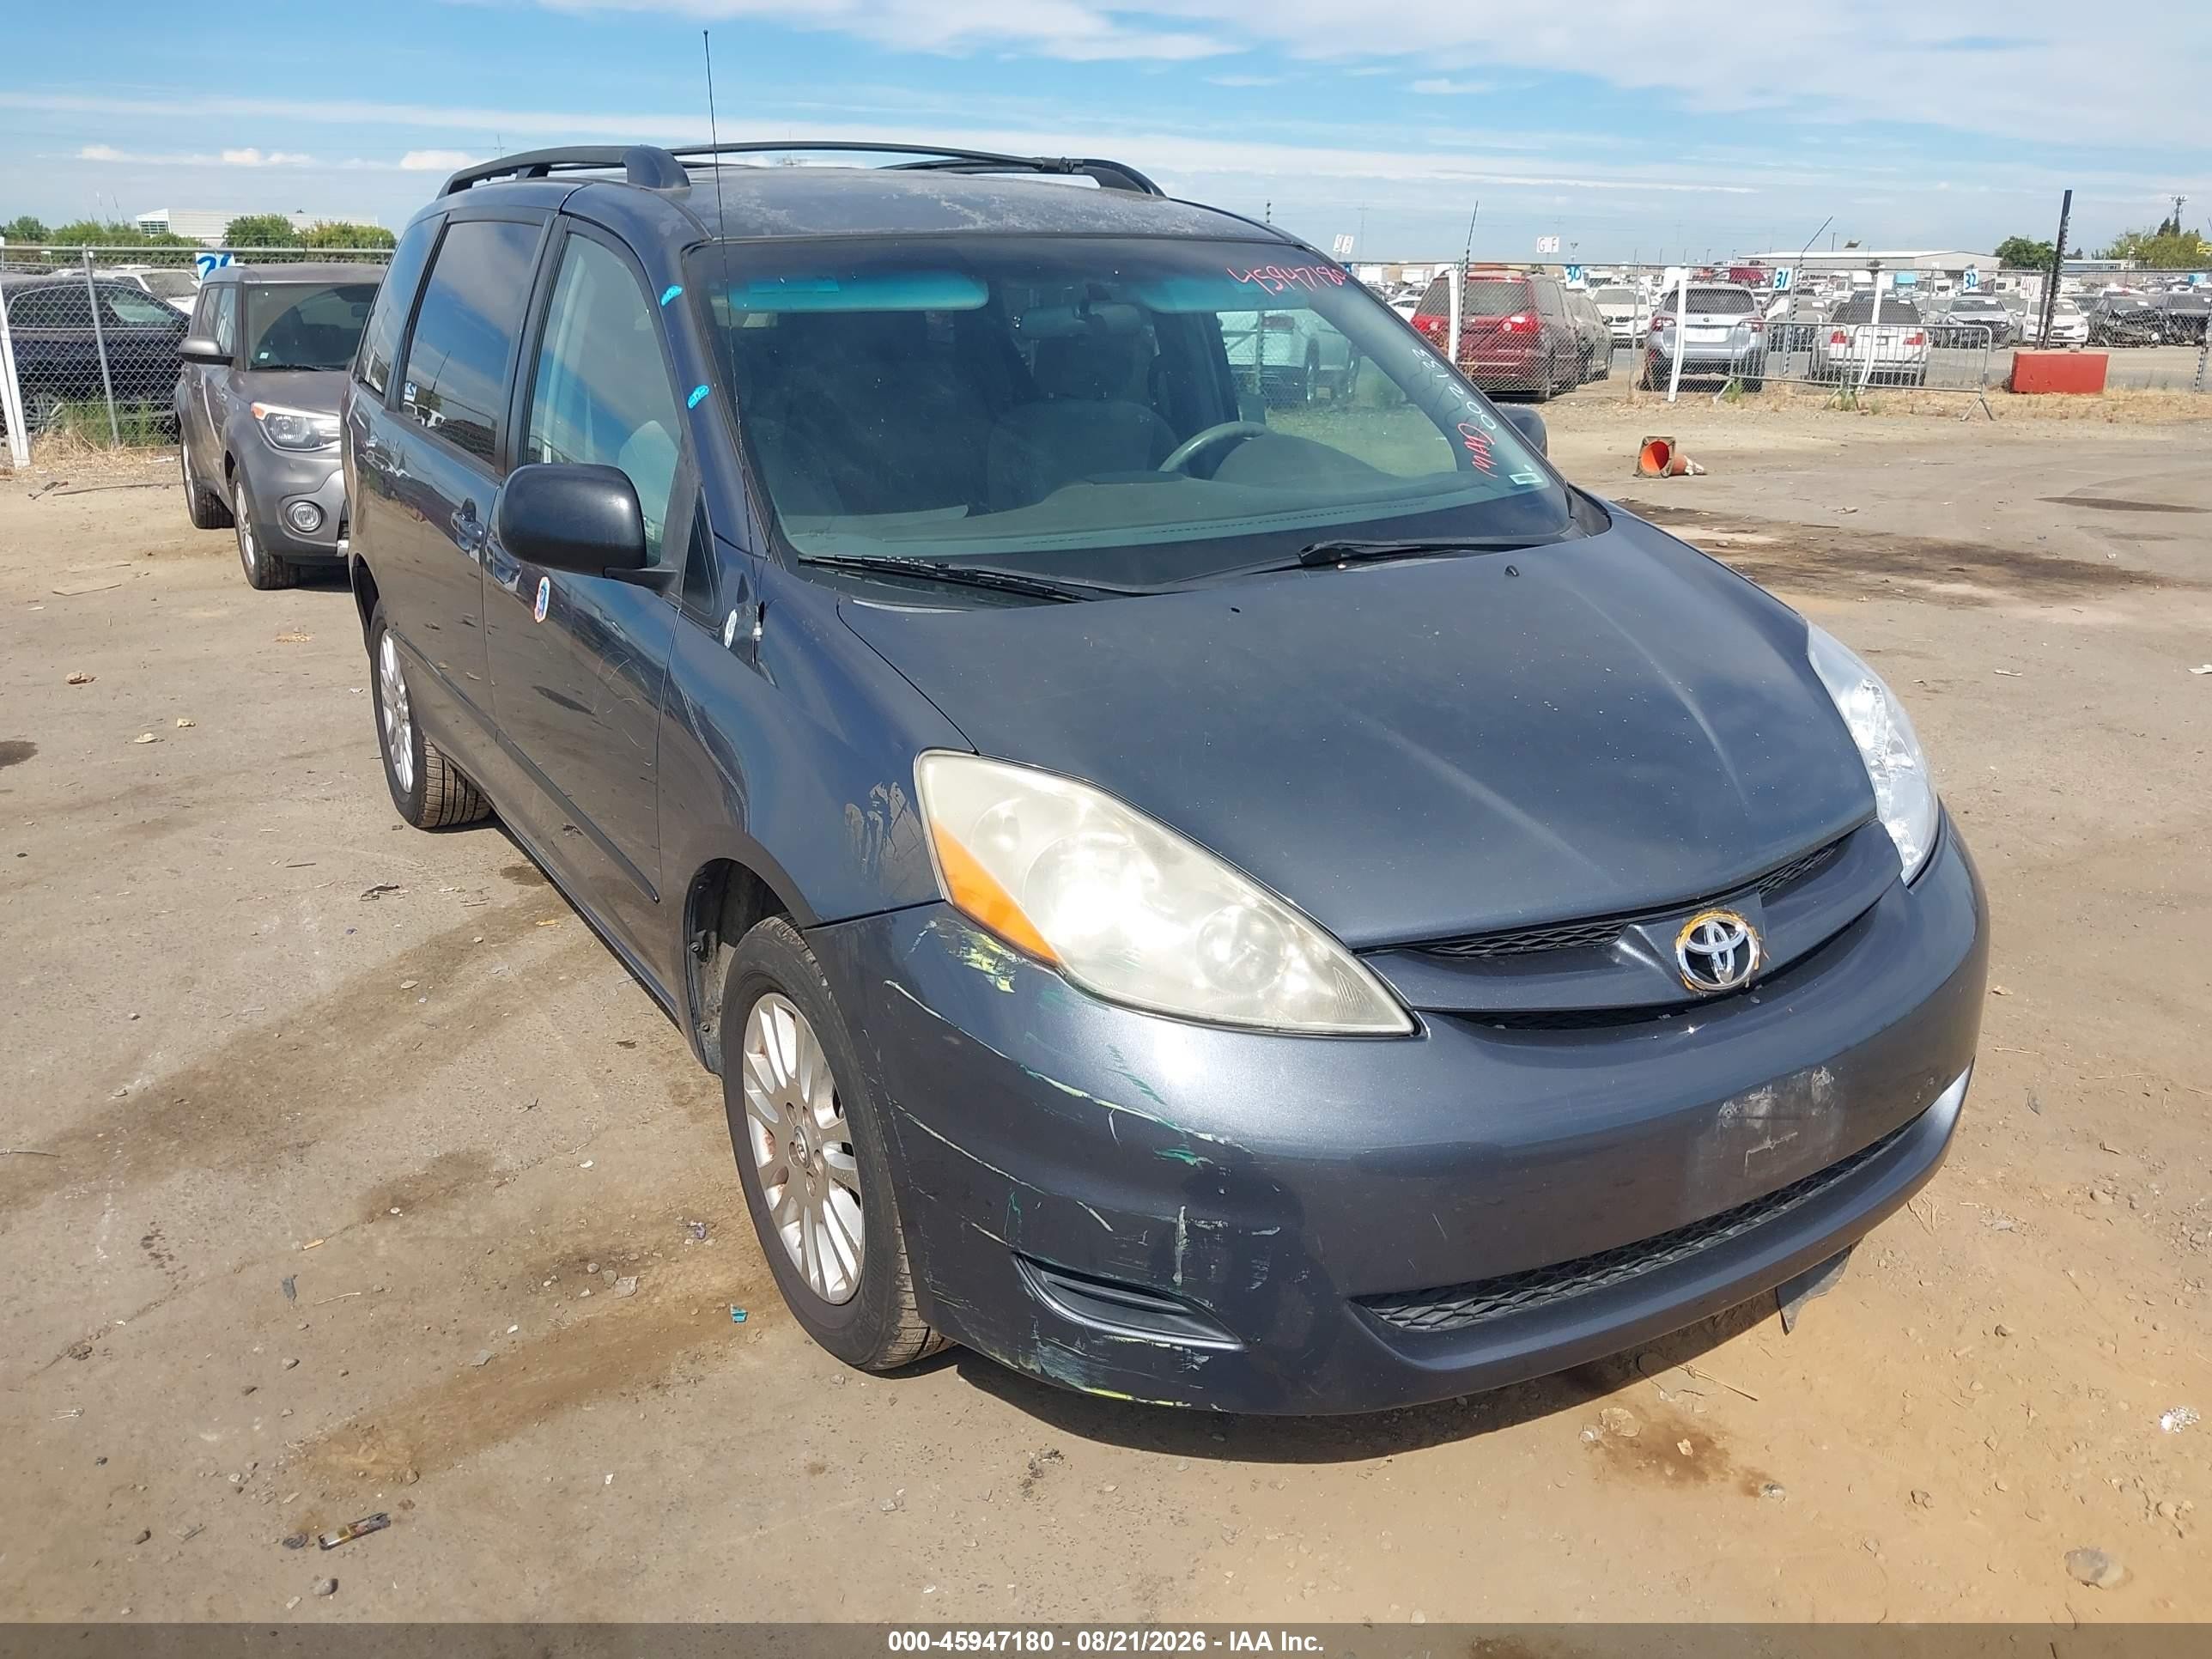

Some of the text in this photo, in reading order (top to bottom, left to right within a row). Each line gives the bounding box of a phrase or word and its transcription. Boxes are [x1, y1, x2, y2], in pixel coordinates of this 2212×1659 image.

[1565, 264, 1582, 283] 30
[1774, 270, 1789, 289] 31
[1965, 272, 1978, 290] 32
